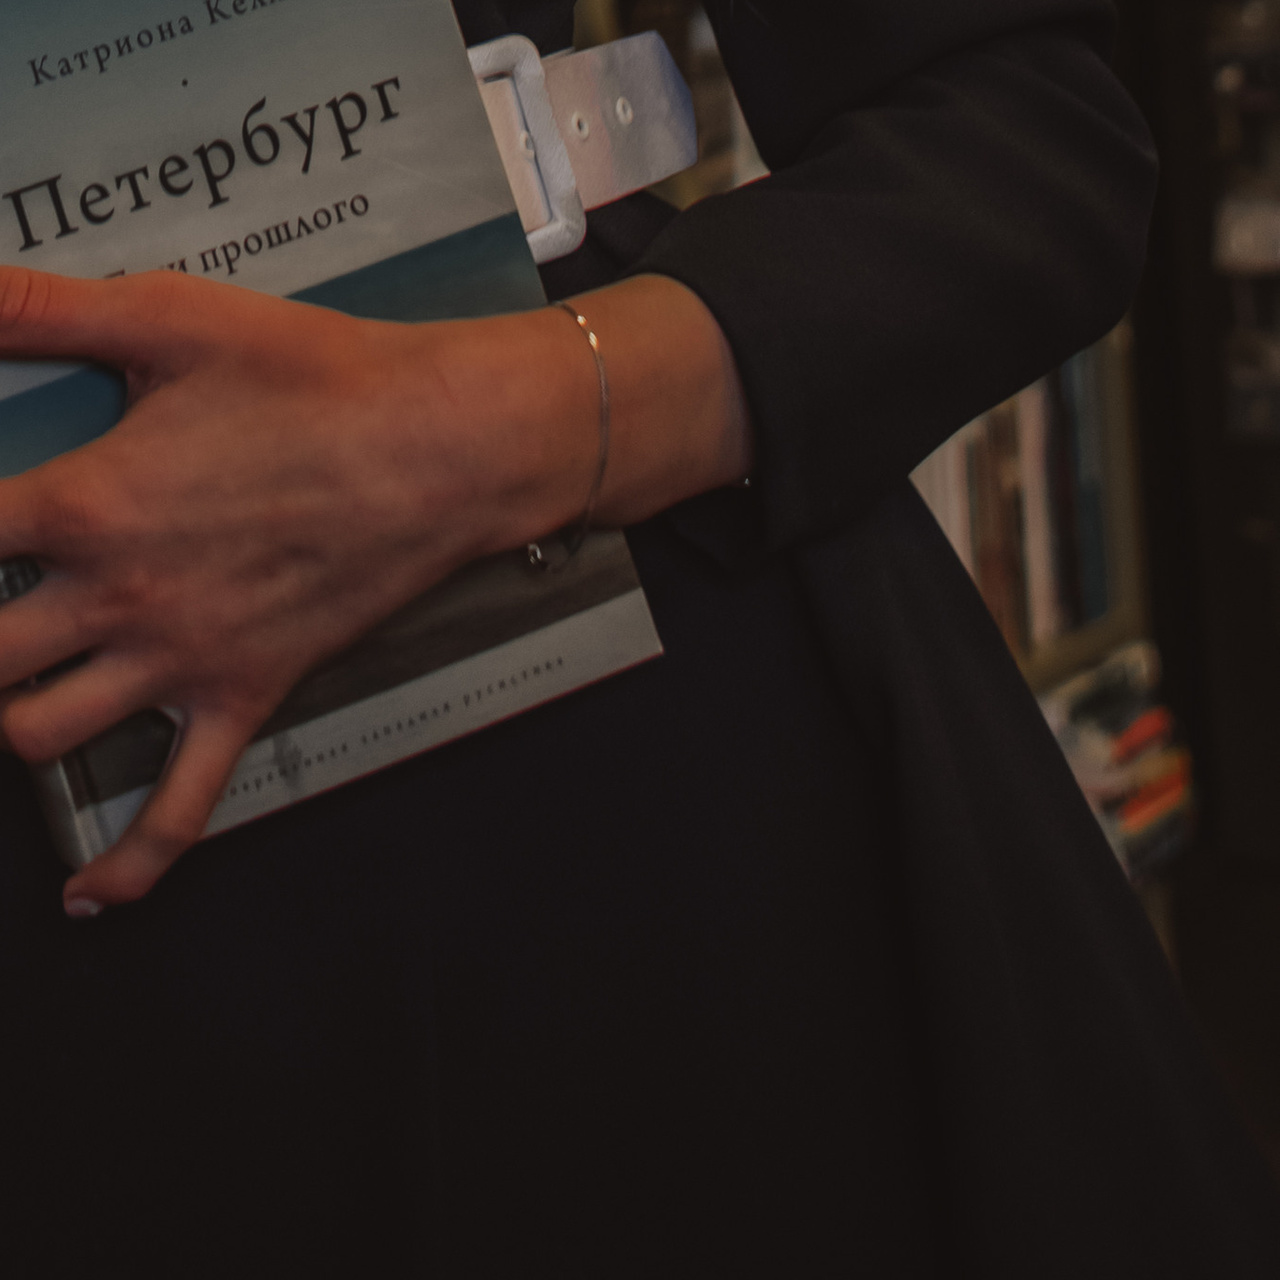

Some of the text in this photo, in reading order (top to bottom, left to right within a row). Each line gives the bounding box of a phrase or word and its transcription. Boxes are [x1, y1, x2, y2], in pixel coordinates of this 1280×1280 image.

[27, 16, 195, 86] Катриона
[2, 76, 401, 252] Петербург
[199, 193, 370, 276] прошлого
[227, 742, 348, 796] овременная
